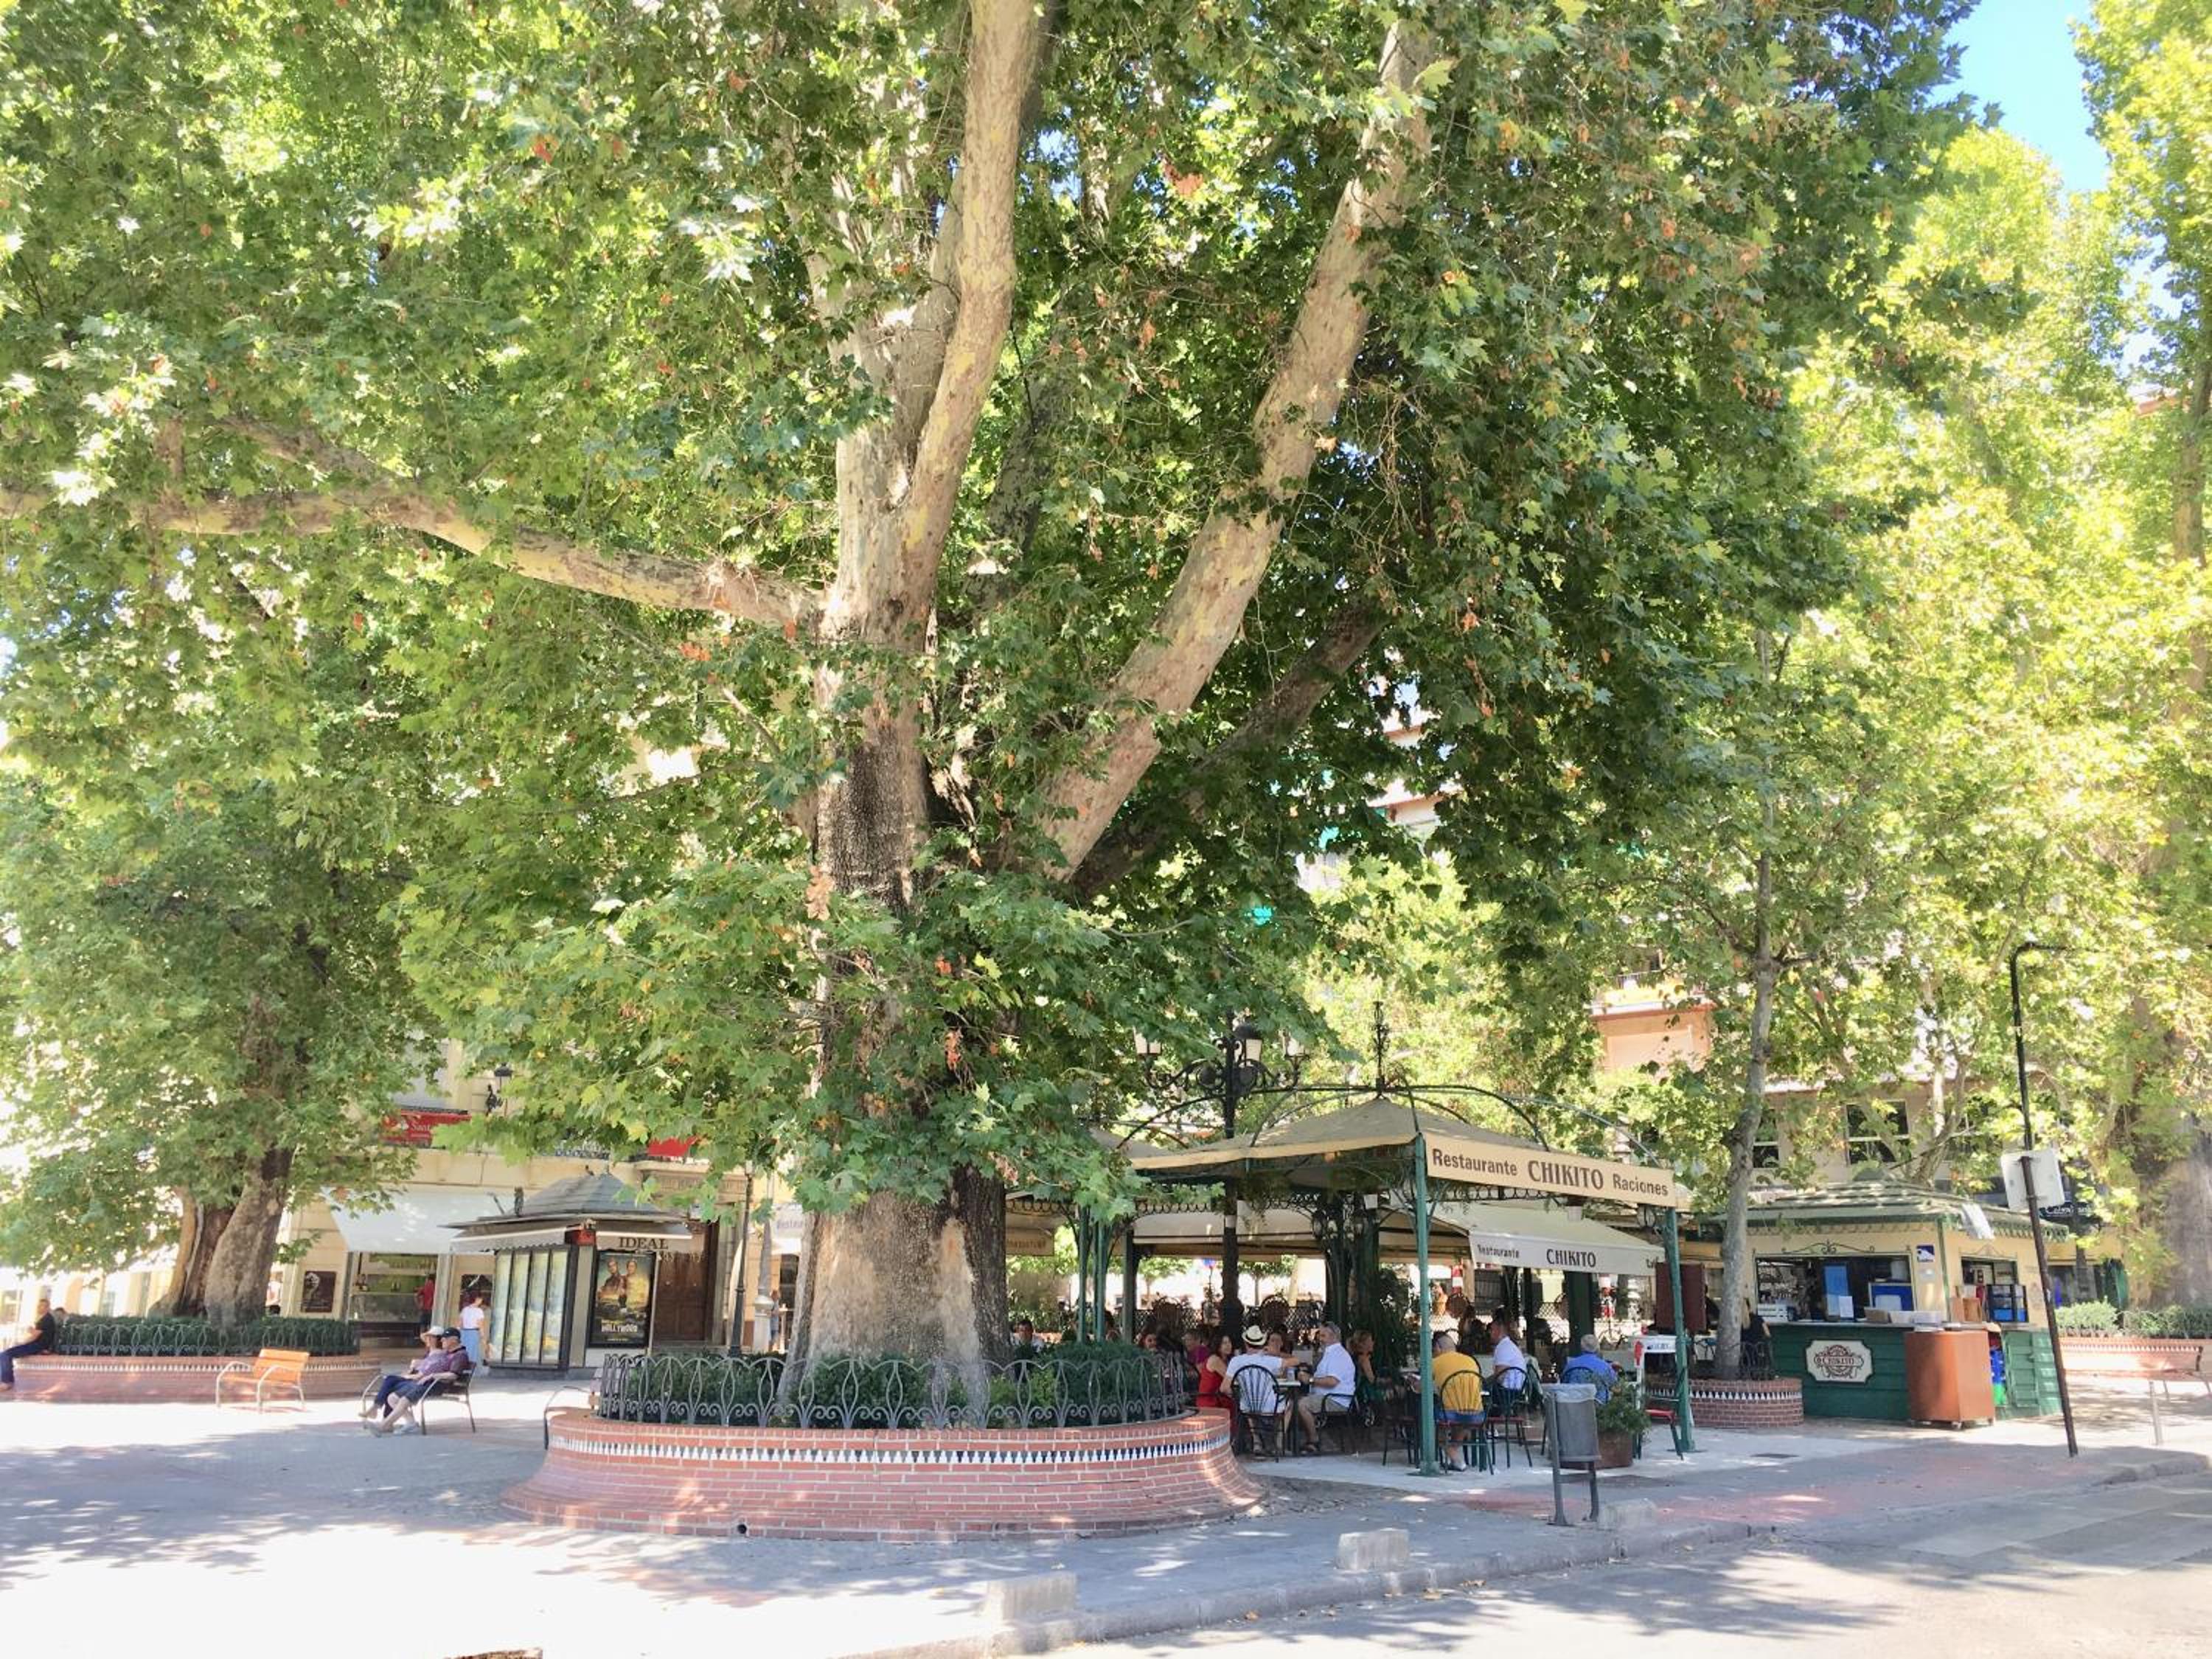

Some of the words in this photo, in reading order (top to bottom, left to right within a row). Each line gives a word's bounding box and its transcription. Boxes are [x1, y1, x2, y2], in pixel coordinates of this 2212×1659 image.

[1432, 1148, 1518, 1177] Restaurante
[1527, 1159, 1604, 1190] CHIKITO
[1613, 1172, 1669, 1197] Raciones
[619, 1237, 669, 1250] IDEAL
[1546, 1248, 1596, 1267] CHIKITO
